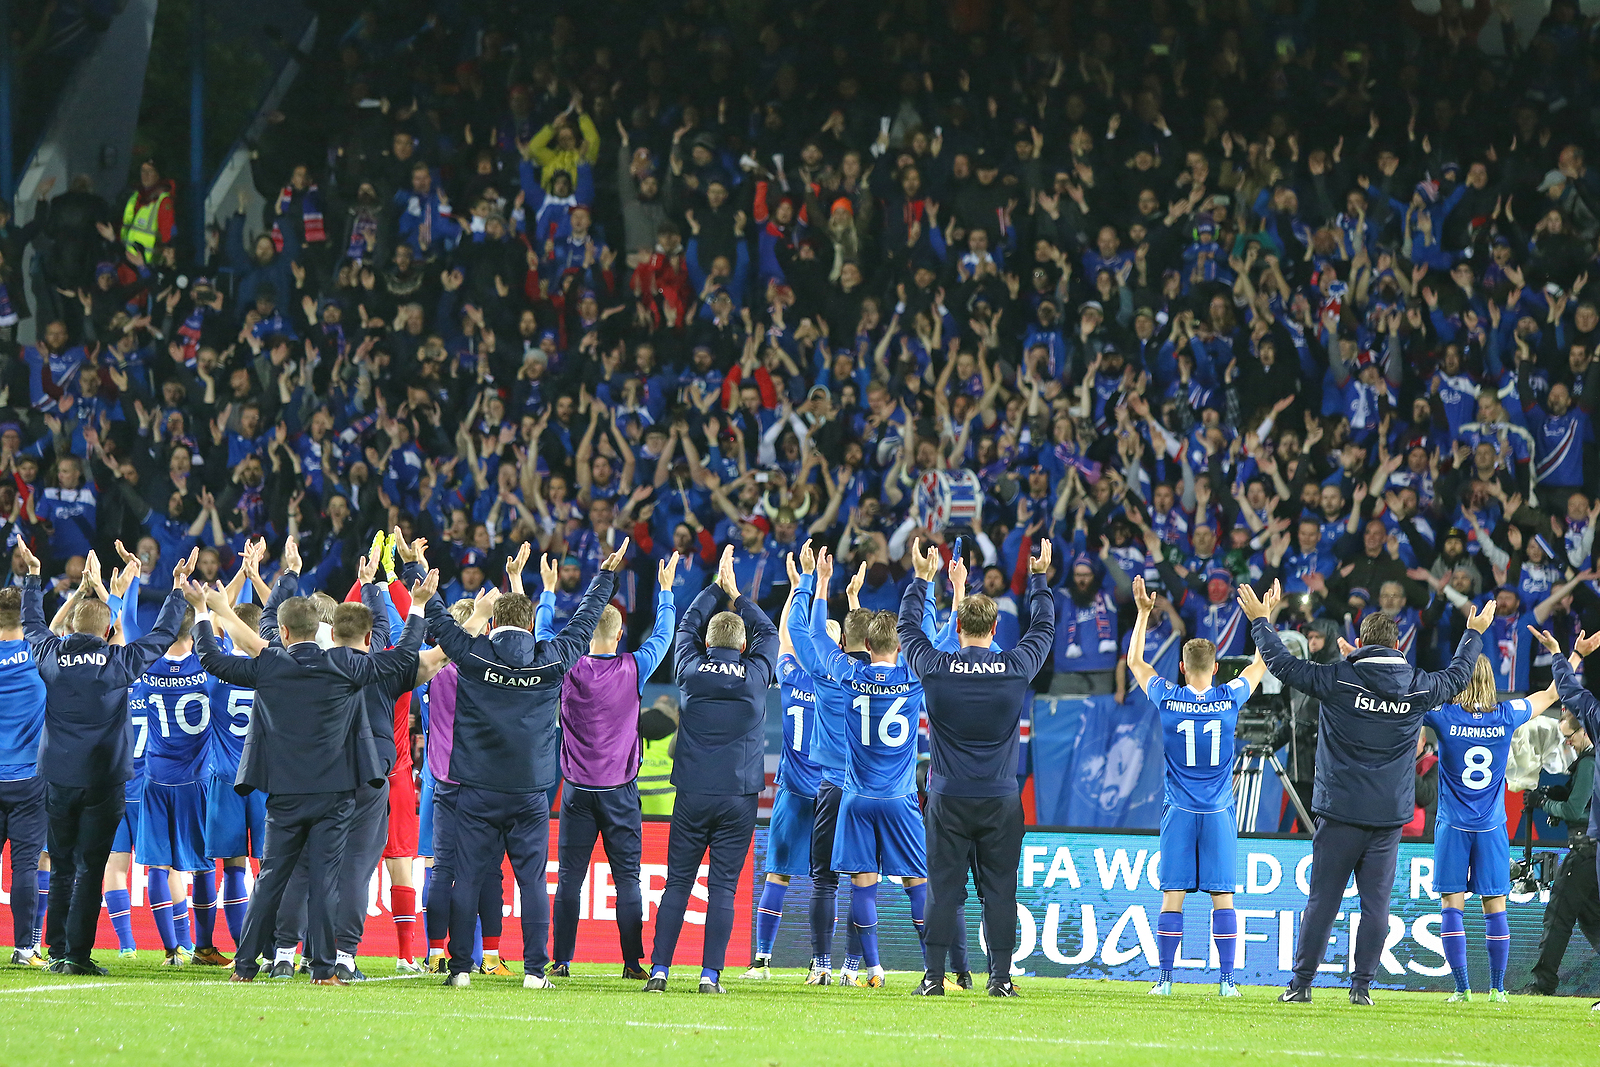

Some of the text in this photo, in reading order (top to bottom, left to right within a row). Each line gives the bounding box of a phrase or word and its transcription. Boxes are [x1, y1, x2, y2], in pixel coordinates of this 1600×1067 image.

[57, 652, 107, 668] SLAND
[949, 661, 1006, 675] ÍSLAND
[484, 667, 542, 688] ÍSLAND
[148, 692, 211, 738] 10
[226, 689, 255, 736] 5
[1165, 698, 1233, 714] FINNBOGASON
[1354, 694, 1412, 715] ÍSLAND
[852, 694, 910, 748] 16
[1449, 724, 1506, 739] BJARNASON
[1176, 719, 1222, 767] 11
[1461, 745, 1493, 790] 8
